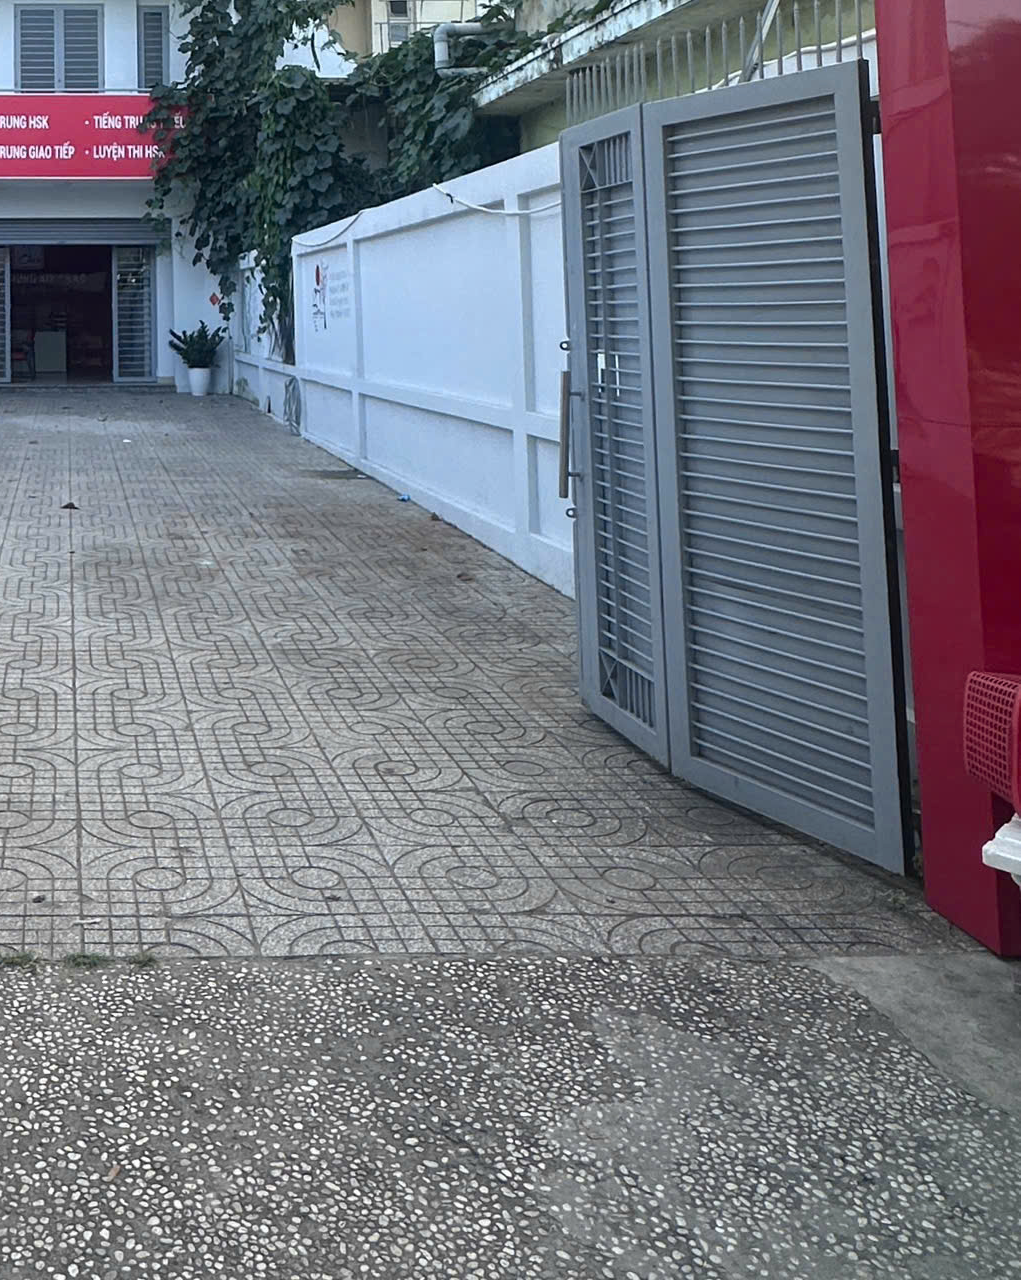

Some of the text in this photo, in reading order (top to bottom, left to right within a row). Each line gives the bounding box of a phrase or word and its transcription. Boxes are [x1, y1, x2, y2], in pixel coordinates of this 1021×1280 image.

[29, 115, 49, 128] HSK
[93, 111, 121, 128] TIẾNG
[29, 145, 52, 159] GIAO
[54, 141, 75, 159] TIẾP
[93, 142, 125, 161] LUYỆN
[127, 145, 142, 158] THI
